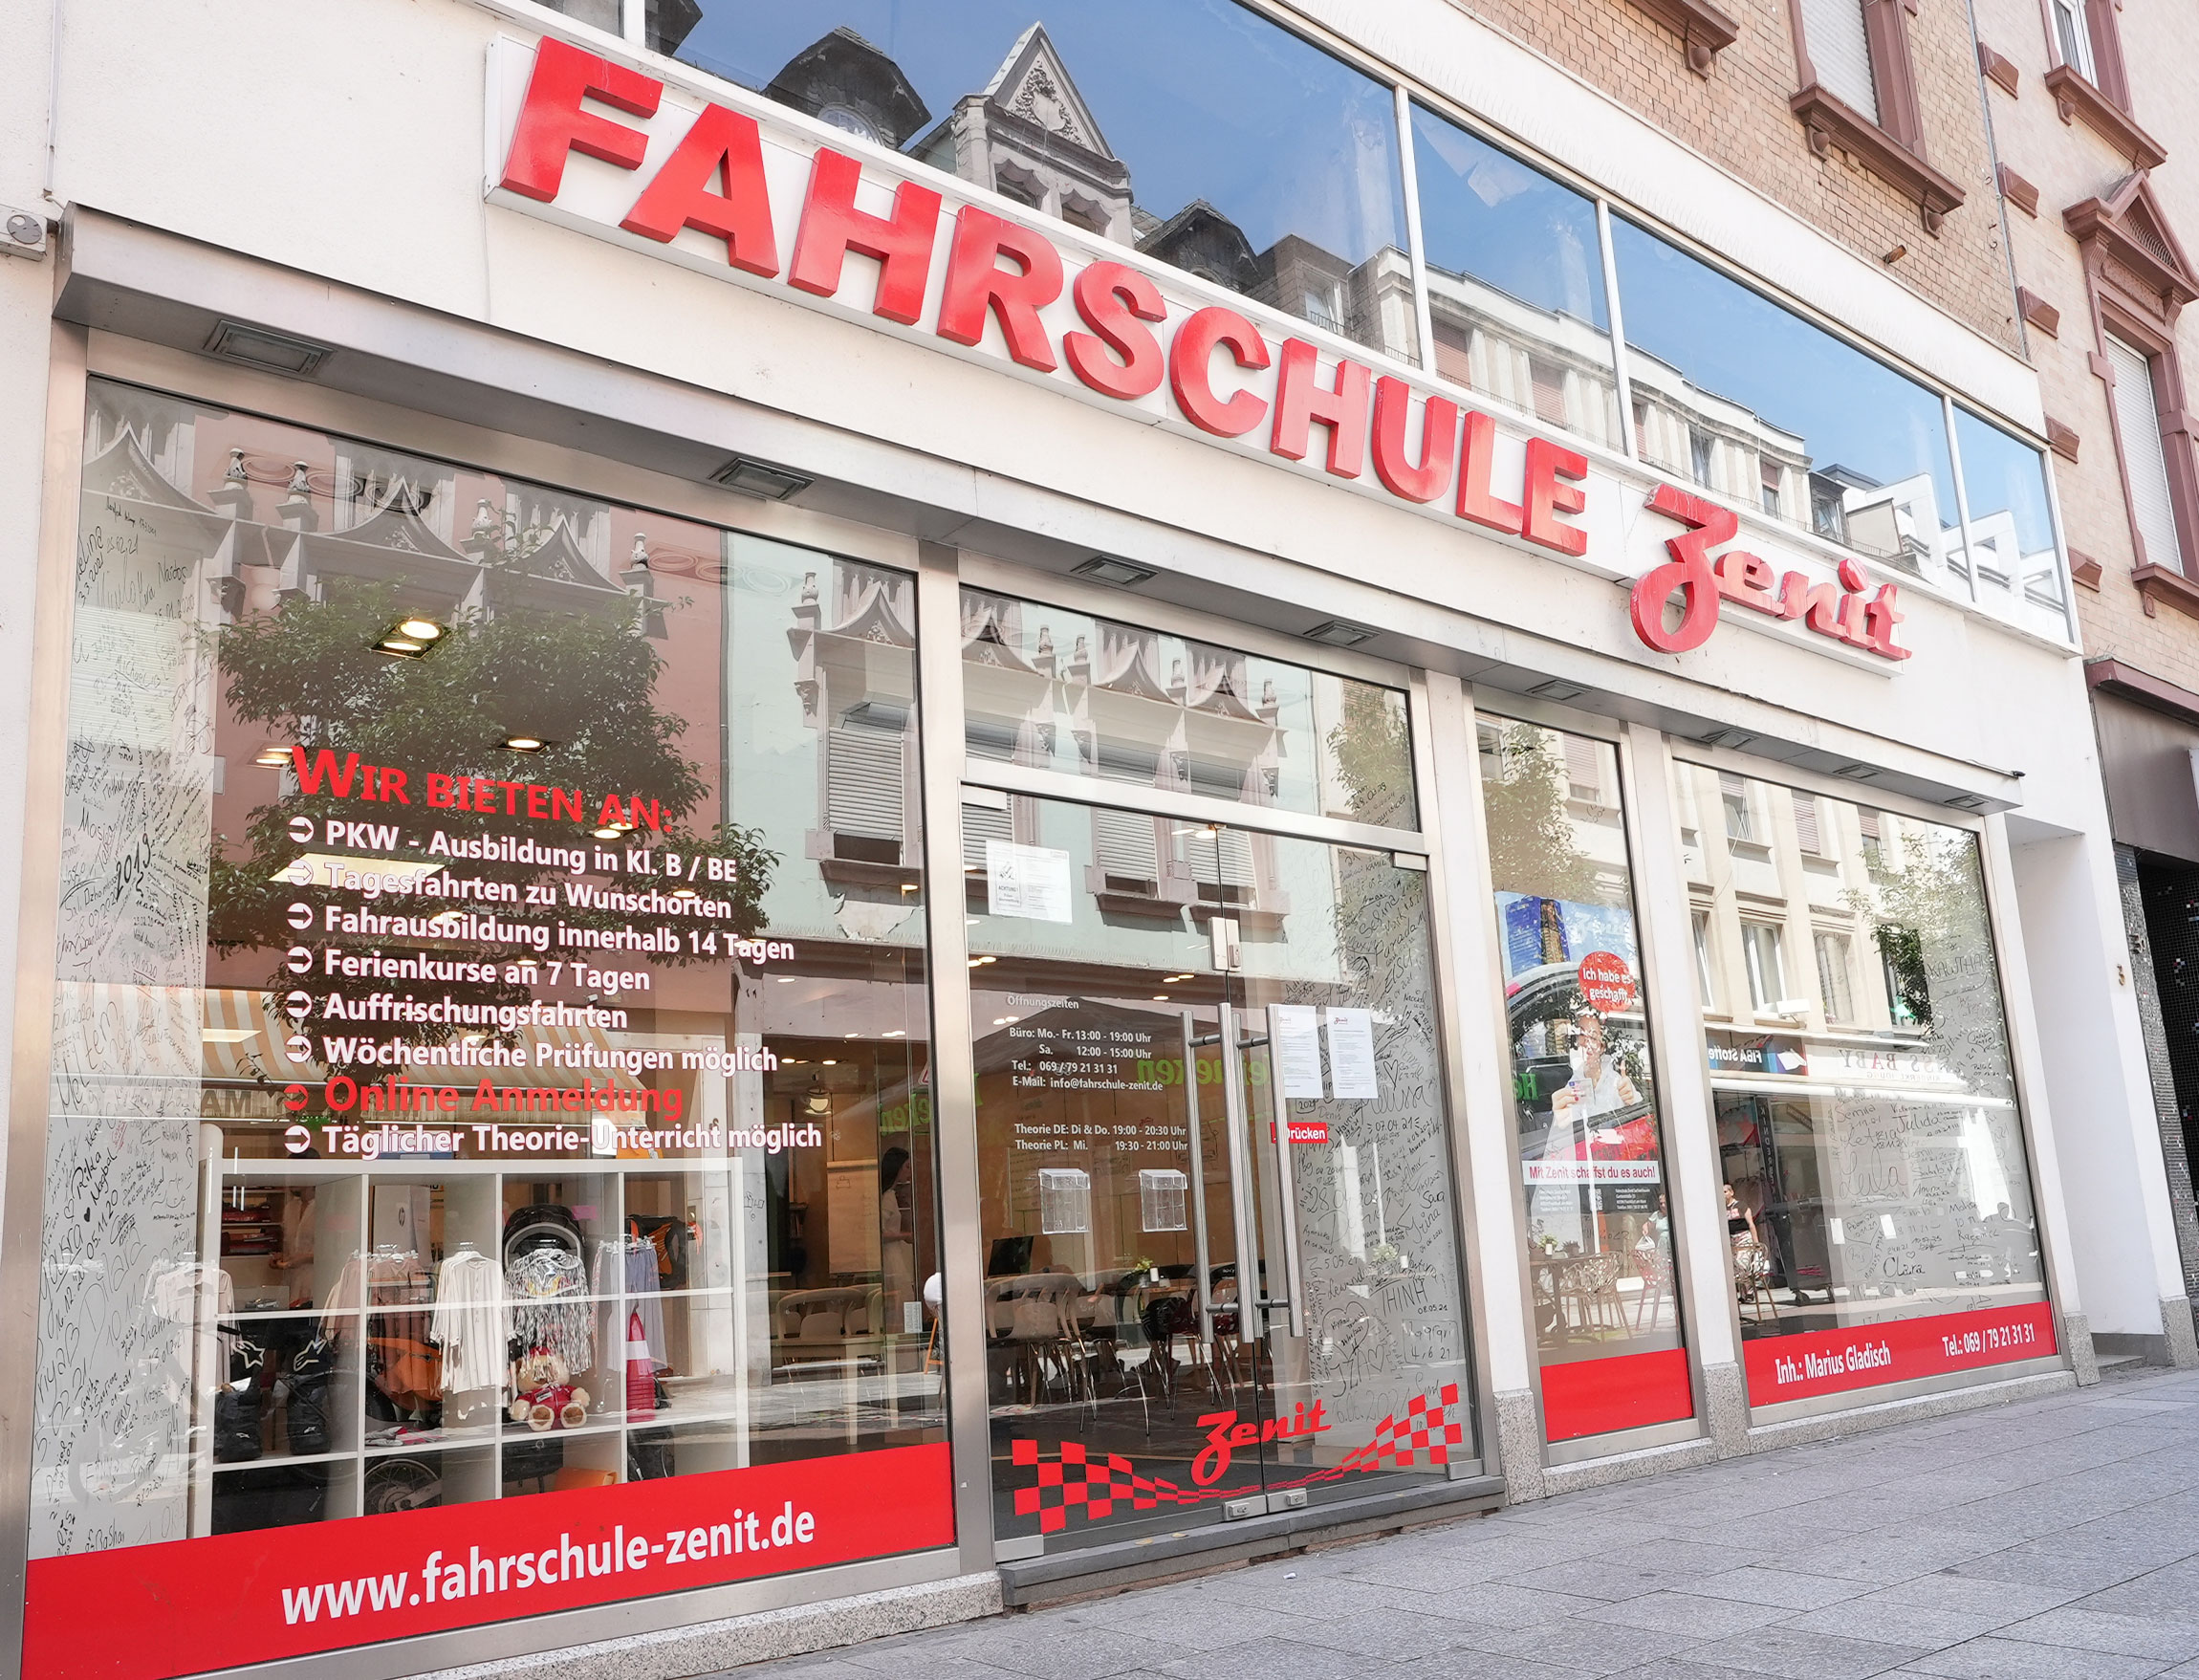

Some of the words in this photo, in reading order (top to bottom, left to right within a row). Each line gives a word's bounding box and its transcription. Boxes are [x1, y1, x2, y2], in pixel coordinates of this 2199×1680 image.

[500, 35, 1588, 556] FAHRSCHULE
[1630, 484, 1912, 661] Zenit
[290, 746, 411, 804] WIR
[426, 772, 582, 824] BIETEN
[599, 794, 672, 833] AN:
[325, 820, 400, 850] PKW
[428, 830, 587, 875] Ausbildung
[594, 845, 619, 871] in
[626, 847, 658, 877] Kl.
[664, 853, 683, 878] B
[686, 854, 700, 883] /
[708, 857, 738, 884] BE
[324, 862, 517, 903] Tagesfahrten
[525, 883, 556, 907] zu
[564, 882, 732, 920] Wunschorten
[324, 905, 550, 952] Fahrausbildung
[557, 925, 682, 956] innerhalb
[687, 929, 718, 957] 14
[726, 935, 795, 966] Tagen
[324, 949, 497, 986] Ferienkurse
[504, 963, 537, 988] an
[548, 963, 562, 989] 7
[570, 964, 651, 997] Tagen
[1582, 968, 1597, 980] Ich
[1598, 969, 1620, 983] habe
[1622, 973, 1631, 984] es
[323, 993, 629, 1034] Auffrischungsfahrten
[1007, 993, 1079, 1010] Öffnungszeiten
[1009, 1027, 1035, 1038] Büro:
[1061, 1029, 1075, 1040] Fr.
[1076, 1030, 1100, 1040] 13:00
[1109, 1031, 1134, 1042] 19:00
[1135, 1032, 1152, 1043] Uhr
[1038, 1044, 1054, 1055] Sa.
[1077, 1045, 1100, 1057] 12:00
[1110, 1047, 1134, 1058] 15:00
[1135, 1048, 1152, 1059] Uhr
[323, 1036, 528, 1070] Wöchentliche
[534, 1043, 673, 1078] Prüfungen
[681, 1046, 779, 1079] möglich
[1012, 1059, 1032, 1072] Tel.:
[1039, 1060, 1057, 1072] 069
[1066, 1061, 1078, 1073] 79
[1080, 1062, 1091, 1073] 21
[1093, 1063, 1104, 1074] 31
[1107, 1063, 1118, 1074] 31
[323, 1075, 459, 1114] Online
[470, 1079, 684, 1122] Anmeldung
[1012, 1076, 1046, 1087] E-Mail:
[1050, 1077, 1164, 1092] info@fahrschule-zenit.de
[322, 1125, 465, 1162] Täglicher
[471, 1124, 722, 1153] Theorie-Unterricht
[728, 1124, 822, 1155] möglich
[1014, 1124, 1051, 1135] Theorie
[1053, 1124, 1069, 1135] DE:
[1071, 1124, 1081, 1135] Di
[1083, 1124, 1093, 1135] &
[1094, 1125, 1110, 1135] Do.
[1112, 1124, 1137, 1135] 19:00
[1144, 1125, 1168, 1136] 20:30
[1170, 1125, 1187, 1136] Uhr
[1015, 1139, 1052, 1150] Theorie
[1054, 1140, 1069, 1150] PL:
[1073, 1140, 1088, 1150] Mi.
[1115, 1140, 1139, 1151] 19:30
[1146, 1140, 1170, 1151] 21:00
[1172, 1140, 1188, 1151] Uhr
[1287, 1124, 1326, 1140] rücken
[1529, 1166, 1544, 1179] Mit
[1546, 1166, 1569, 1179] Zenit
[1572, 1166, 1606, 1179] schafst
[1607, 1166, 1619, 1179] du
[1621, 1167, 1630, 1178] es
[1632, 1166, 1656, 1179] auch!
[1883, 1255, 1926, 1277] Clara
[1942, 1336, 1964, 1358] Tel.:
[1964, 1331, 1980, 1354] 069
[1987, 1327, 2000, 1349] 79
[2000, 1326, 2012, 1347] 21
[2012, 1324, 2024, 1345] 31
[2023, 1322, 2036, 1343] 31
[1774, 1356, 1804, 1384] Inh.:
[1804, 1348, 1845, 1380] Marius
[1845, 1340, 1892, 1373] Gladisch
[1191, 1399, 1333, 1486] Zenit
[281, 1501, 816, 1625] www.fahrschule-zenit.de
